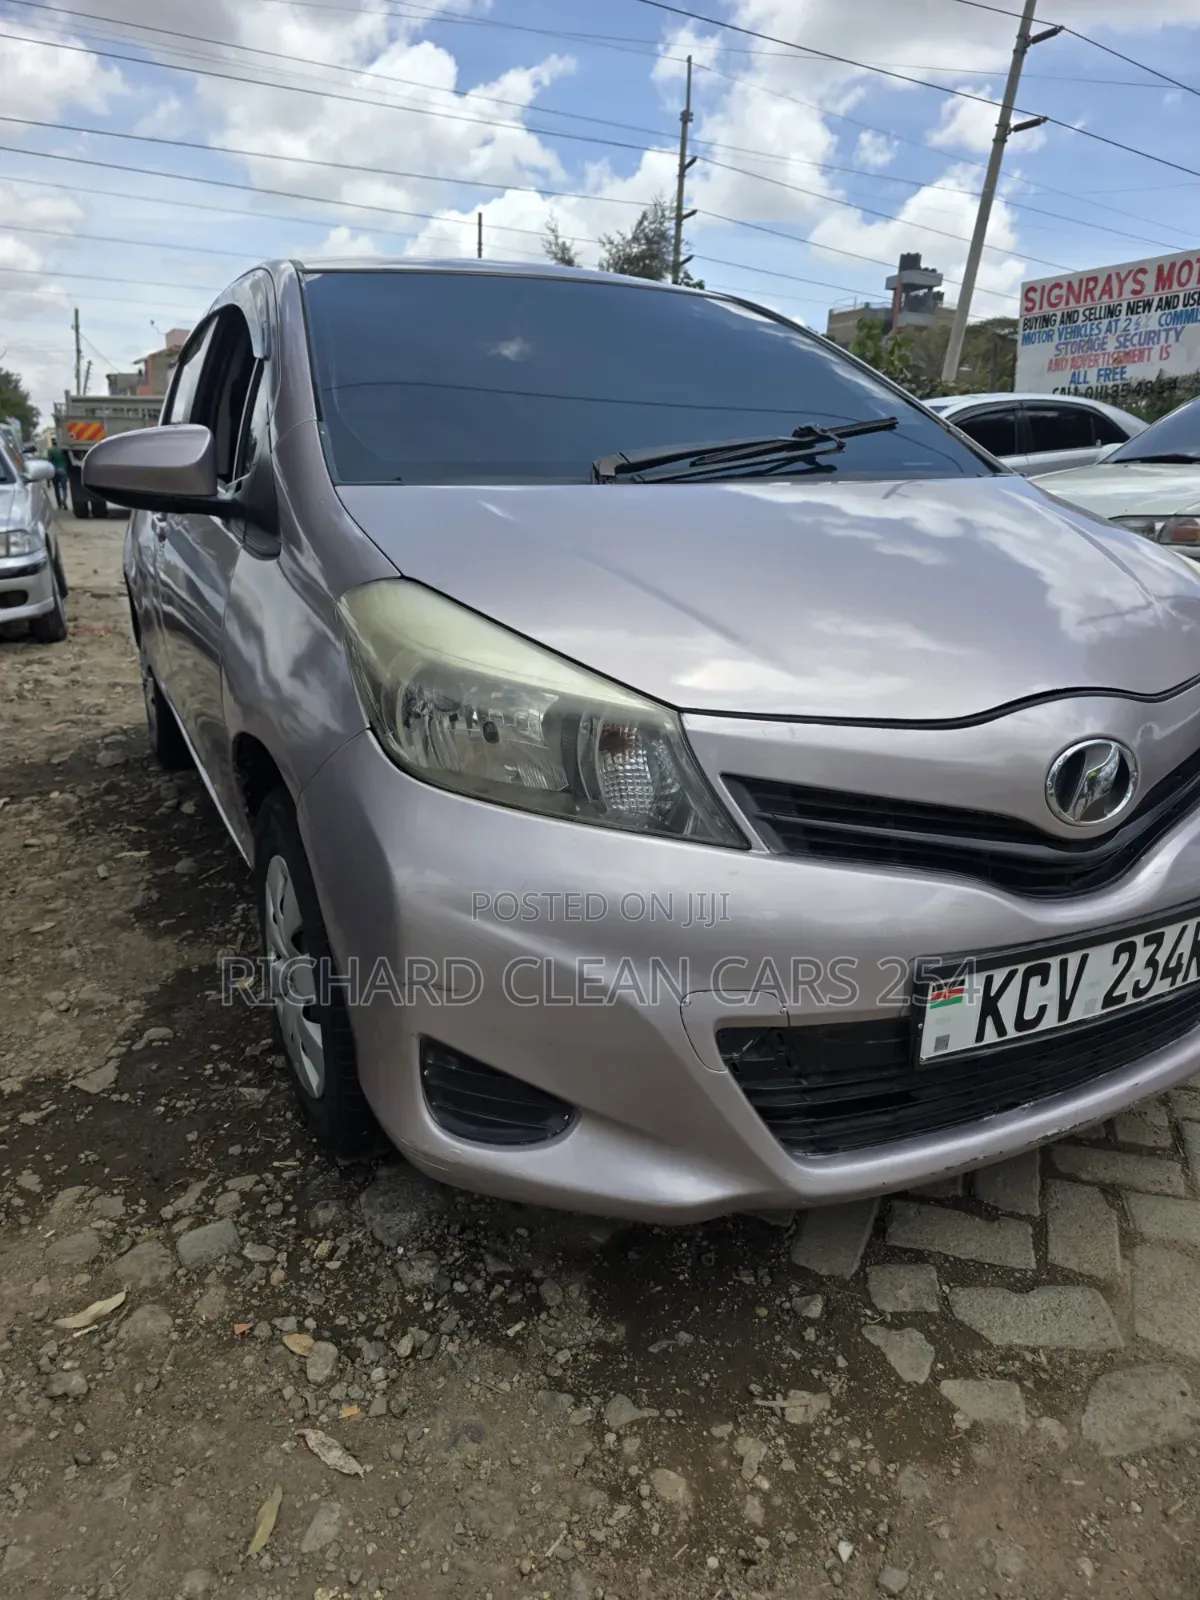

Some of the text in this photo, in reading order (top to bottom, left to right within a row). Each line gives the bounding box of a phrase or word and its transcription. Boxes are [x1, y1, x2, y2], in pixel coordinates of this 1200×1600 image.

[1024, 268, 1148, 313] SIGNRAYS
[1023, 314, 1057, 332] BUYING
[1059, 310, 1079, 327] AND
[1081, 303, 1122, 323] SELLING
[1126, 298, 1155, 316] NEW
[1155, 294, 1180, 312] AND
[1022, 330, 1055, 347] MOTOR
[1057, 321, 1102, 341] VEHICLES
[1104, 317, 1121, 336] AT
[1054, 327, 1184, 357] STORAGE SECURITY
[1047, 357, 1068, 373] AND
[1159, 345, 1172, 360] IS
[1069, 366, 1127, 385] ALL FREE
[975, 953, 1089, 1043] KCV
